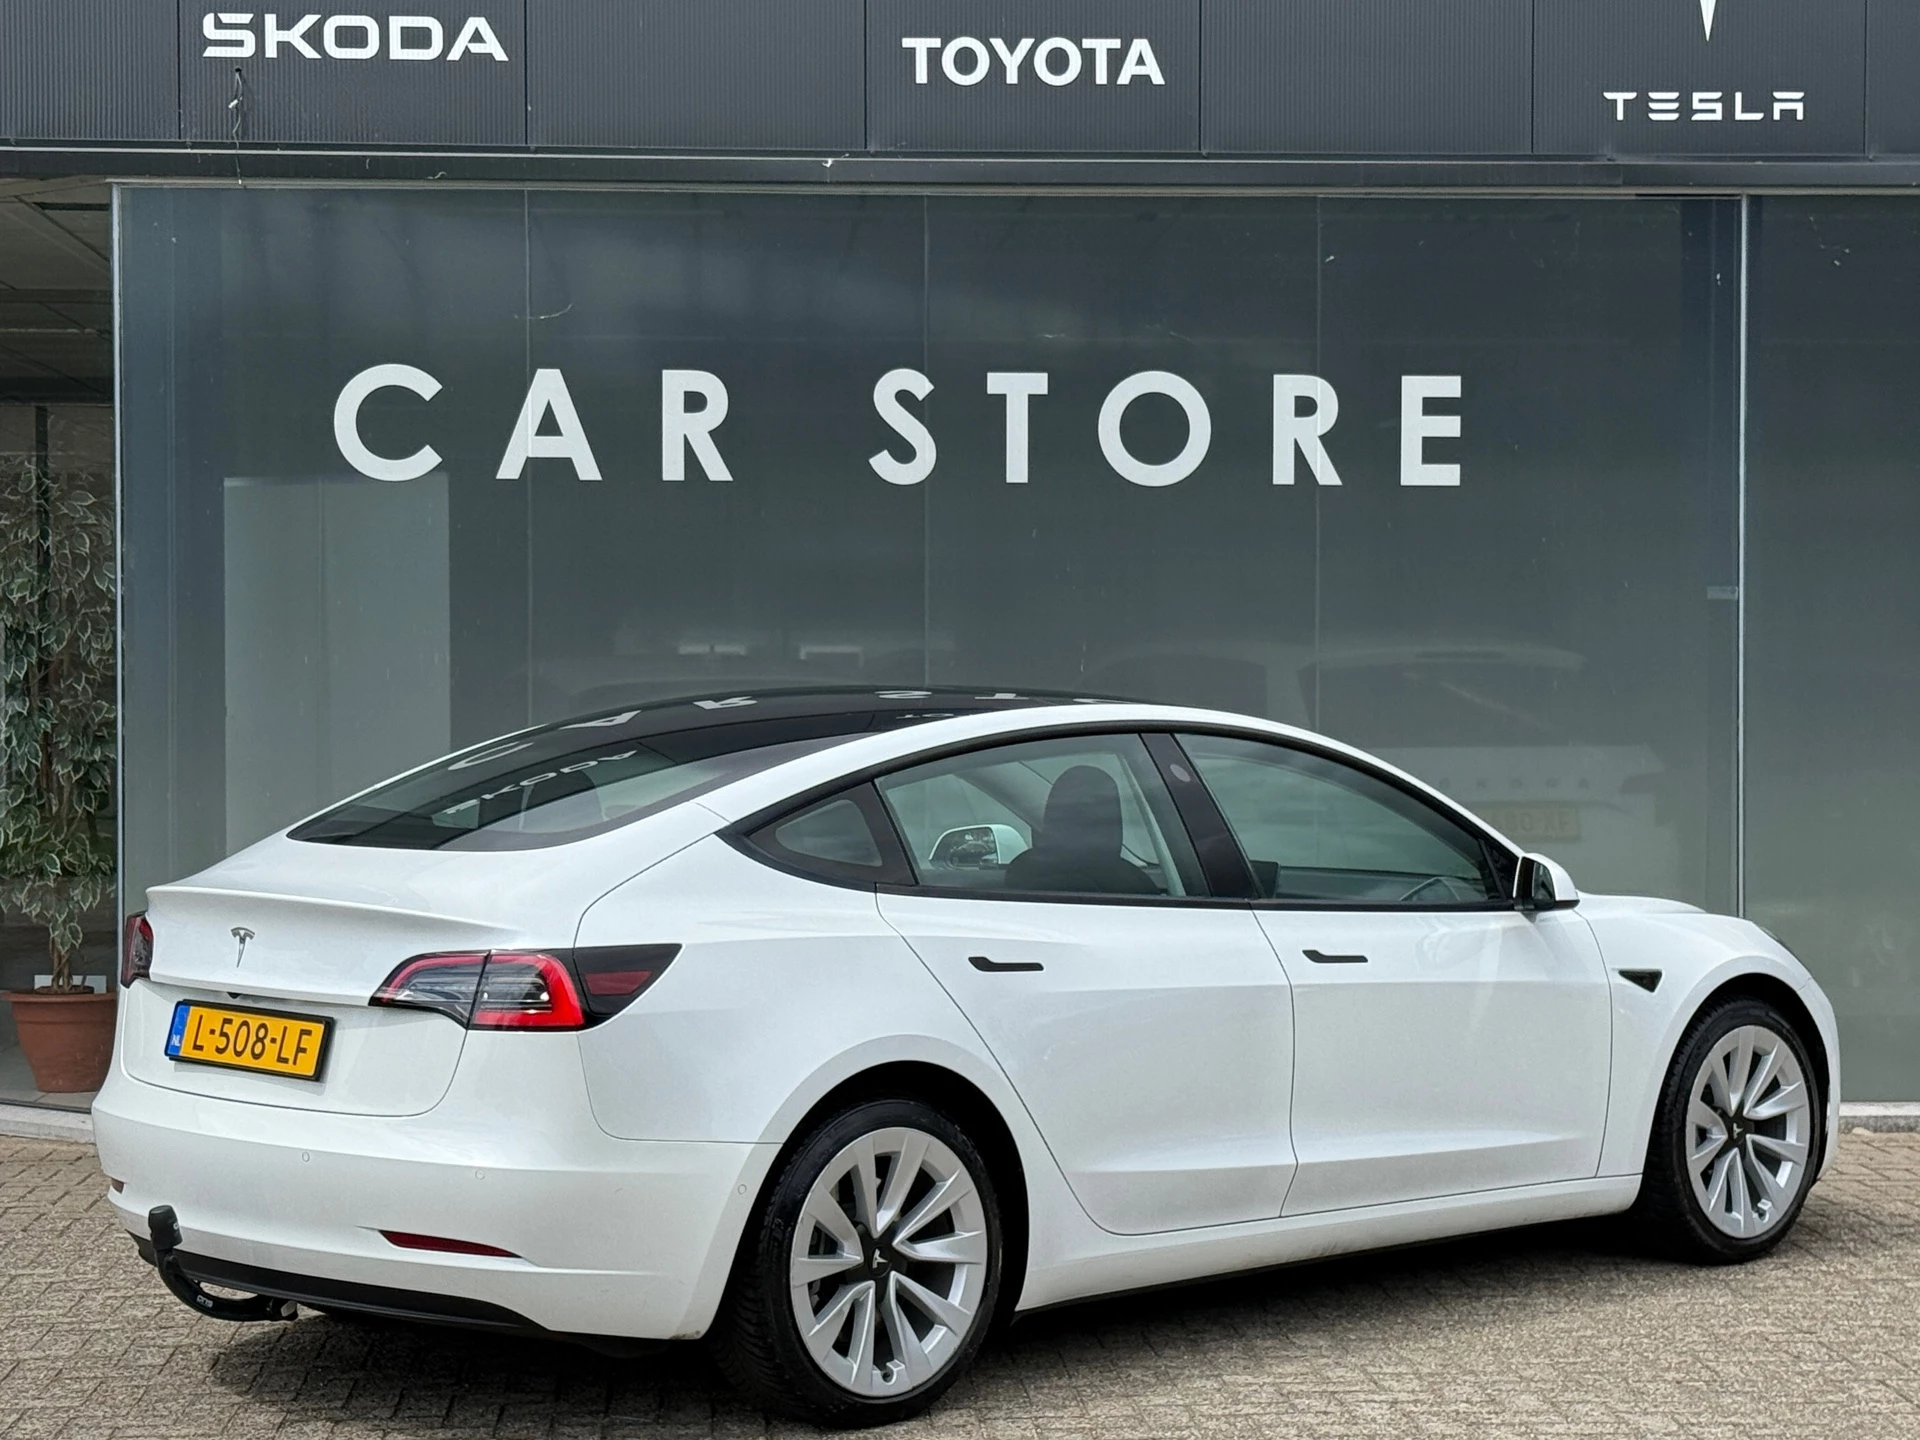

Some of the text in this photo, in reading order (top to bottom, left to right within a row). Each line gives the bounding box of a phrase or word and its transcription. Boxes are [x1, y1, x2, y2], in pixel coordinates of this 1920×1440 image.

[203, 13, 508, 61] SKODA
[902, 37, 1165, 86] TOYOTA
[1603, 92, 1804, 120] TESLA
[334, 364, 1461, 486] CAR STORE
[171, 1034, 181, 1047] NL
[192, 1014, 313, 1066] L-508-LF
